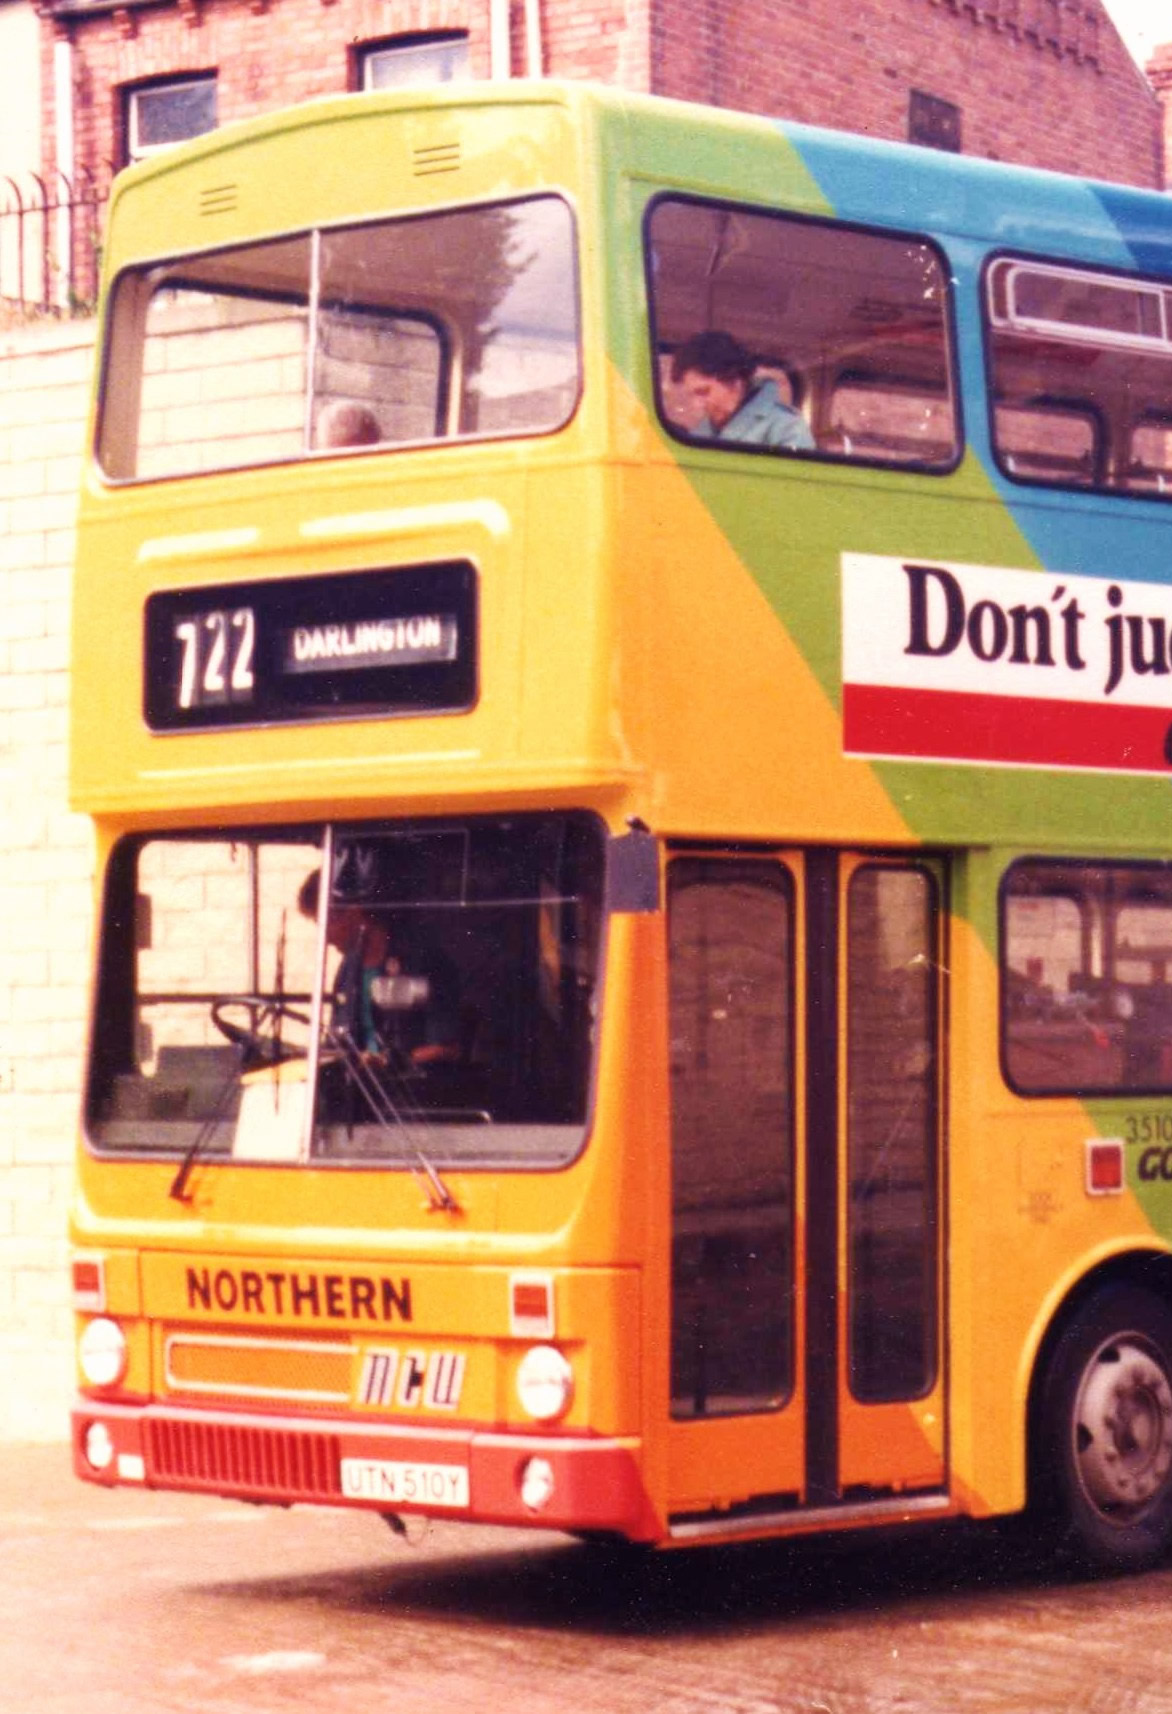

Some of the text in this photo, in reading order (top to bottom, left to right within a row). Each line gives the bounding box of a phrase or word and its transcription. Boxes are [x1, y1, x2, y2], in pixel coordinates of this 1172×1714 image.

[902, 565, 1086, 670] Don't
[176, 606, 442, 709] 722 DARLINGTON
[187, 1267, 413, 1322] NORTHERN
[347, 1464, 463, 1501] UTN 510Y
